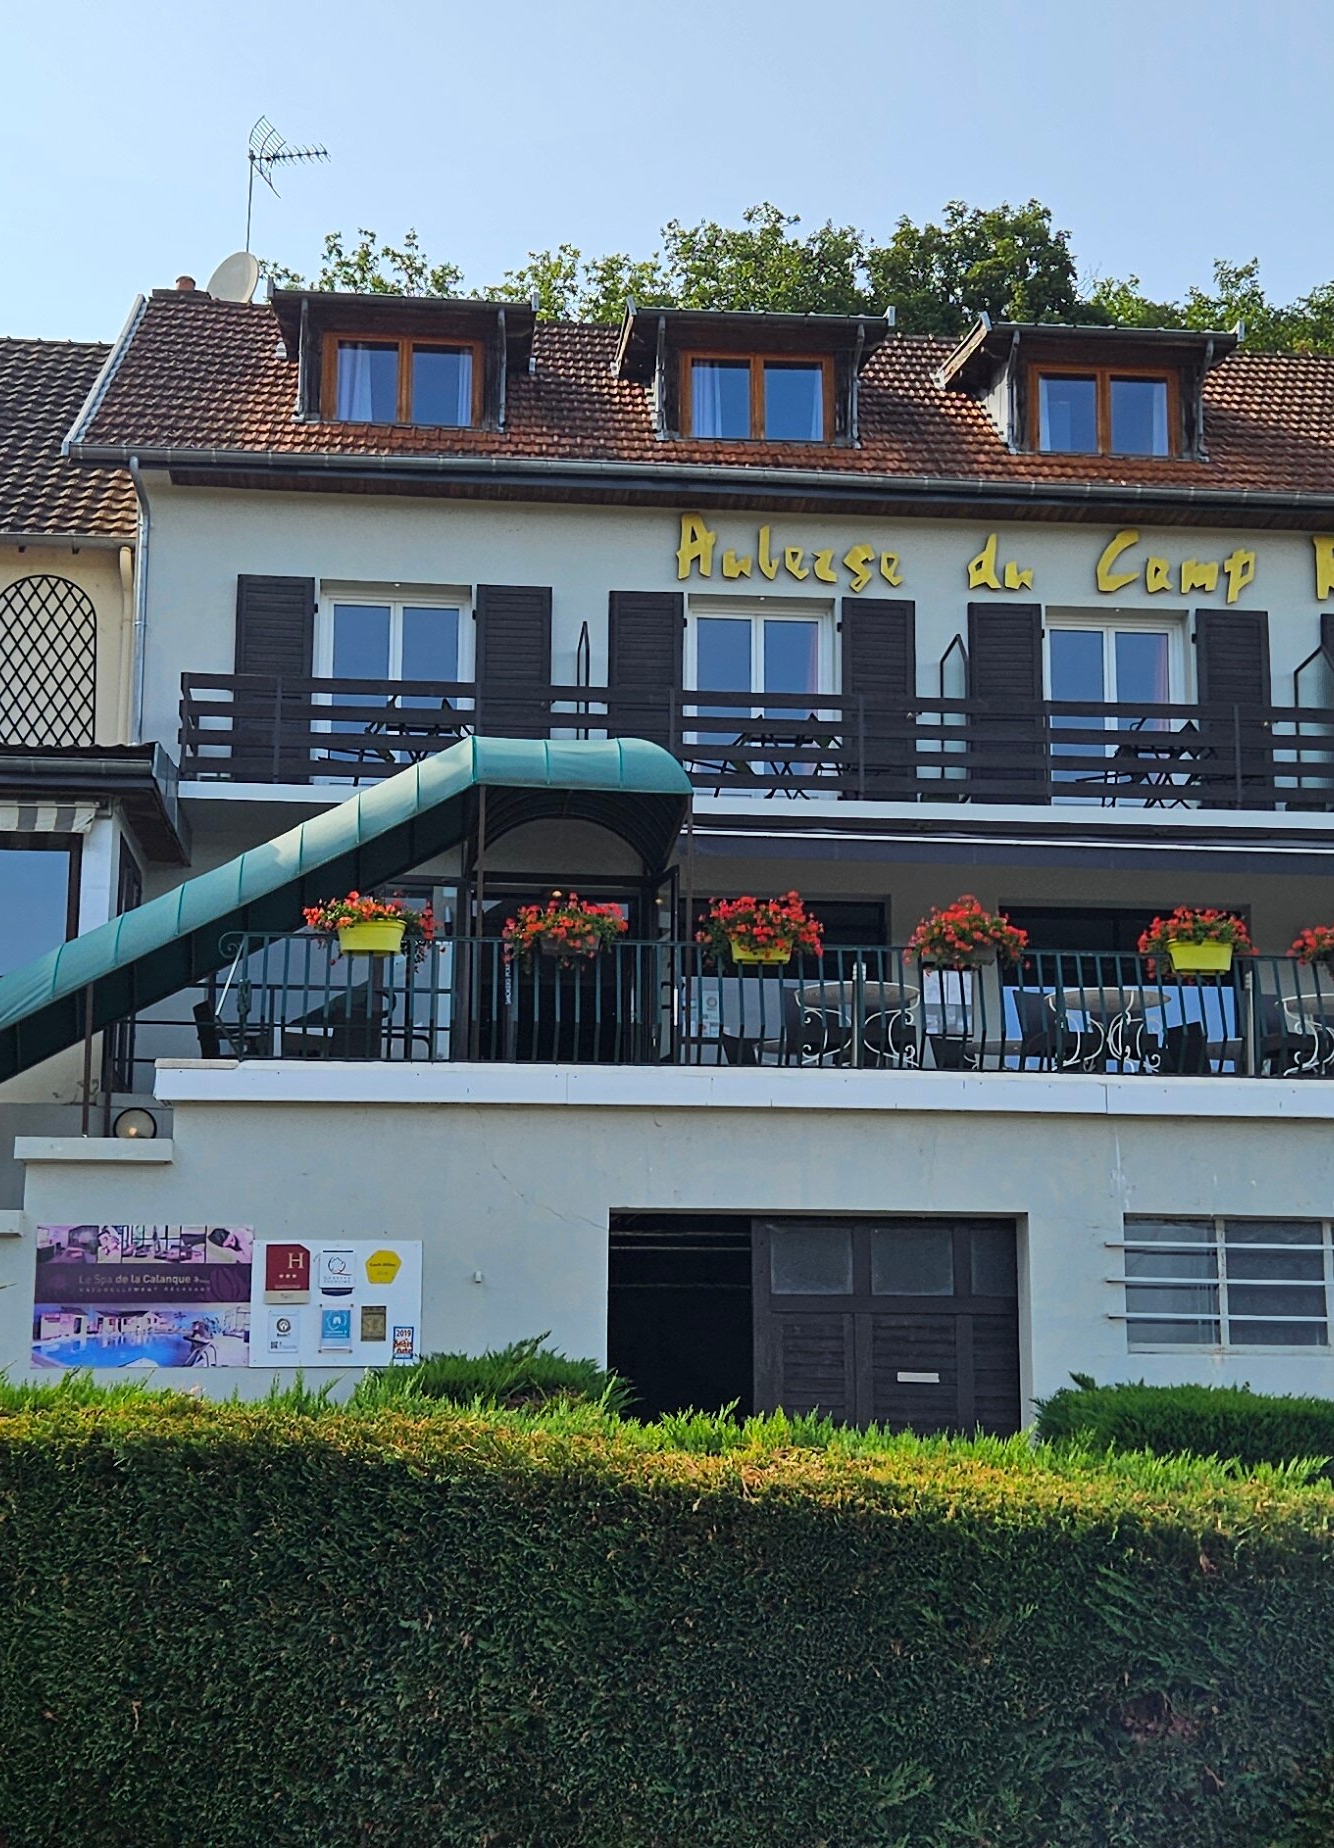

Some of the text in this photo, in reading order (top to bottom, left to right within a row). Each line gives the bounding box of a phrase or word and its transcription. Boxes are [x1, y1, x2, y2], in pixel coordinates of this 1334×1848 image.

[967, 532, 1034, 591] du
[1096, 528, 1257, 604] Camp
[288, 1252, 305, 1269] H
[94, 1273, 113, 1286] Spa
[115, 1274, 129, 1284] de
[130, 1274, 141, 1284] la
[142, 1274, 192, 1286] Calanque
[396, 1329, 412, 1338] 2019
